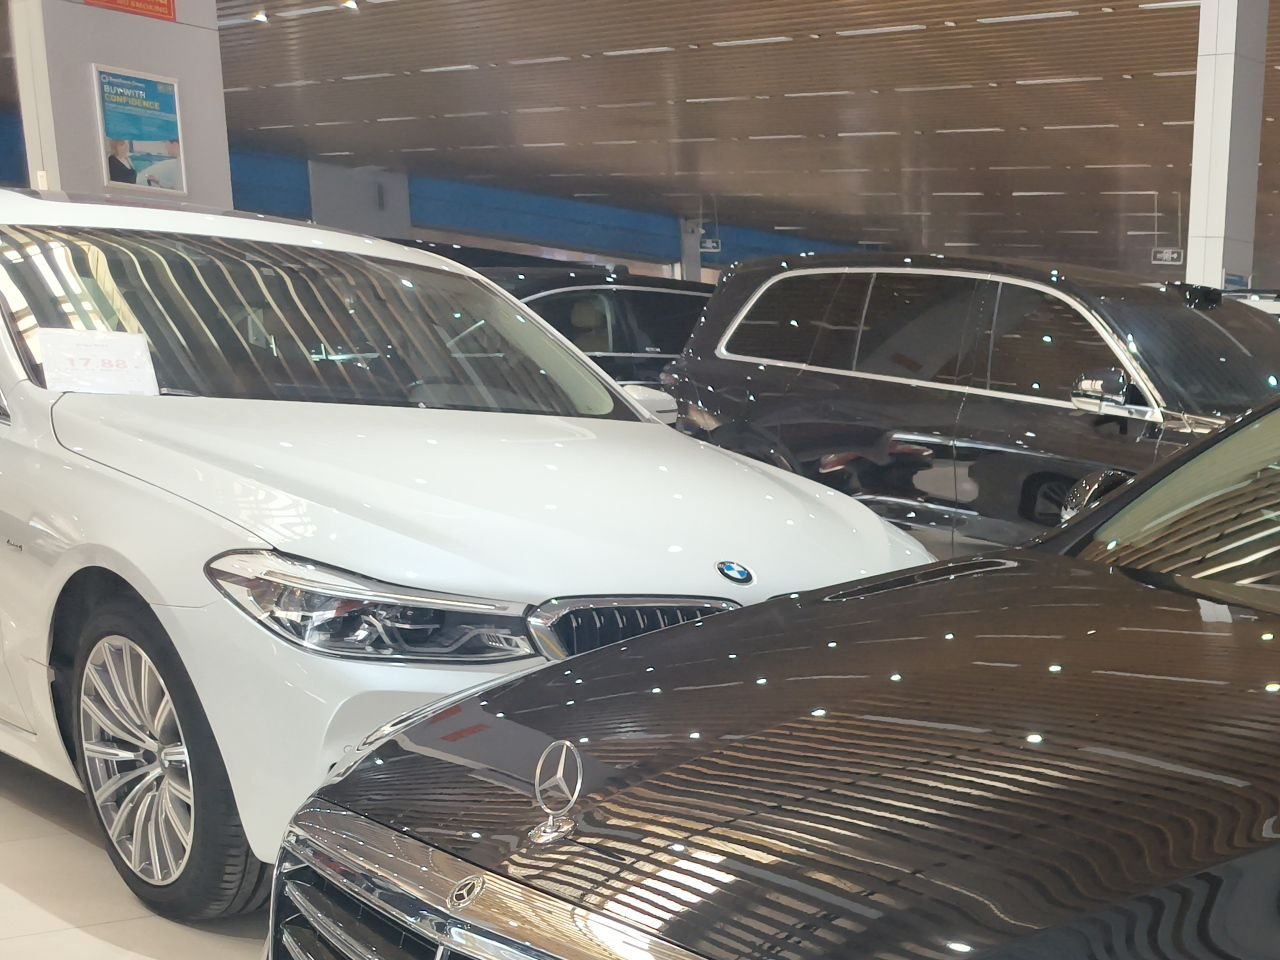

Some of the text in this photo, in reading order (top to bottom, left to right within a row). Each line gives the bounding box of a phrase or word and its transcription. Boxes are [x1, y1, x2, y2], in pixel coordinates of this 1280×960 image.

[130, 1, 169, 14] SMOKING
[104, 84, 121, 95] BUY
[122, 87, 146, 99] WITH
[104, 93, 160, 110] CONFIDENCE
